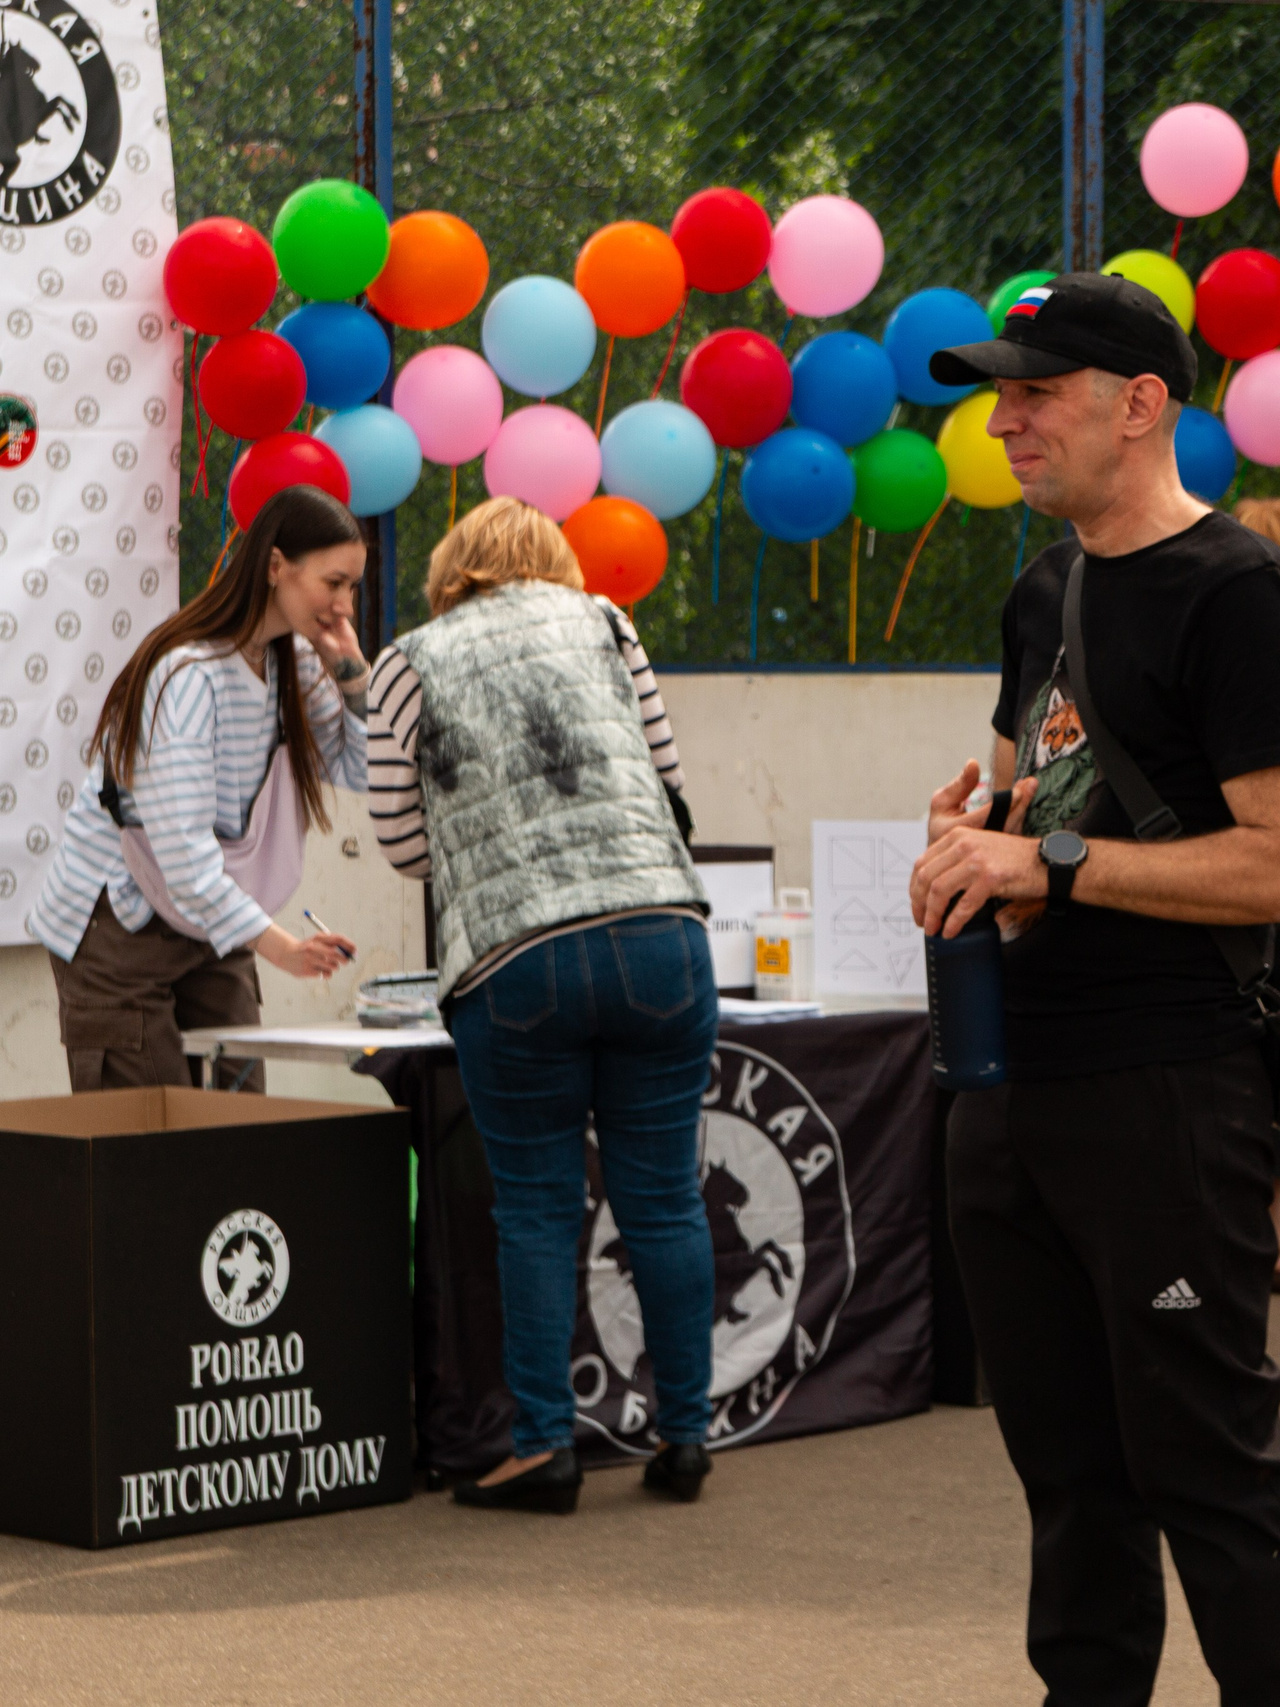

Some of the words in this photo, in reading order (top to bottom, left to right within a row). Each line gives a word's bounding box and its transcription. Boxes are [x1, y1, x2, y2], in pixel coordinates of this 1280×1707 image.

[1152, 1298, 1202, 1309] adidas
[175, 1388, 322, 1451] ПОМОЩЬ
[117, 1451, 291, 1536] ДЕТСКОМУ
[296, 1435, 387, 1506] ДОМУ
